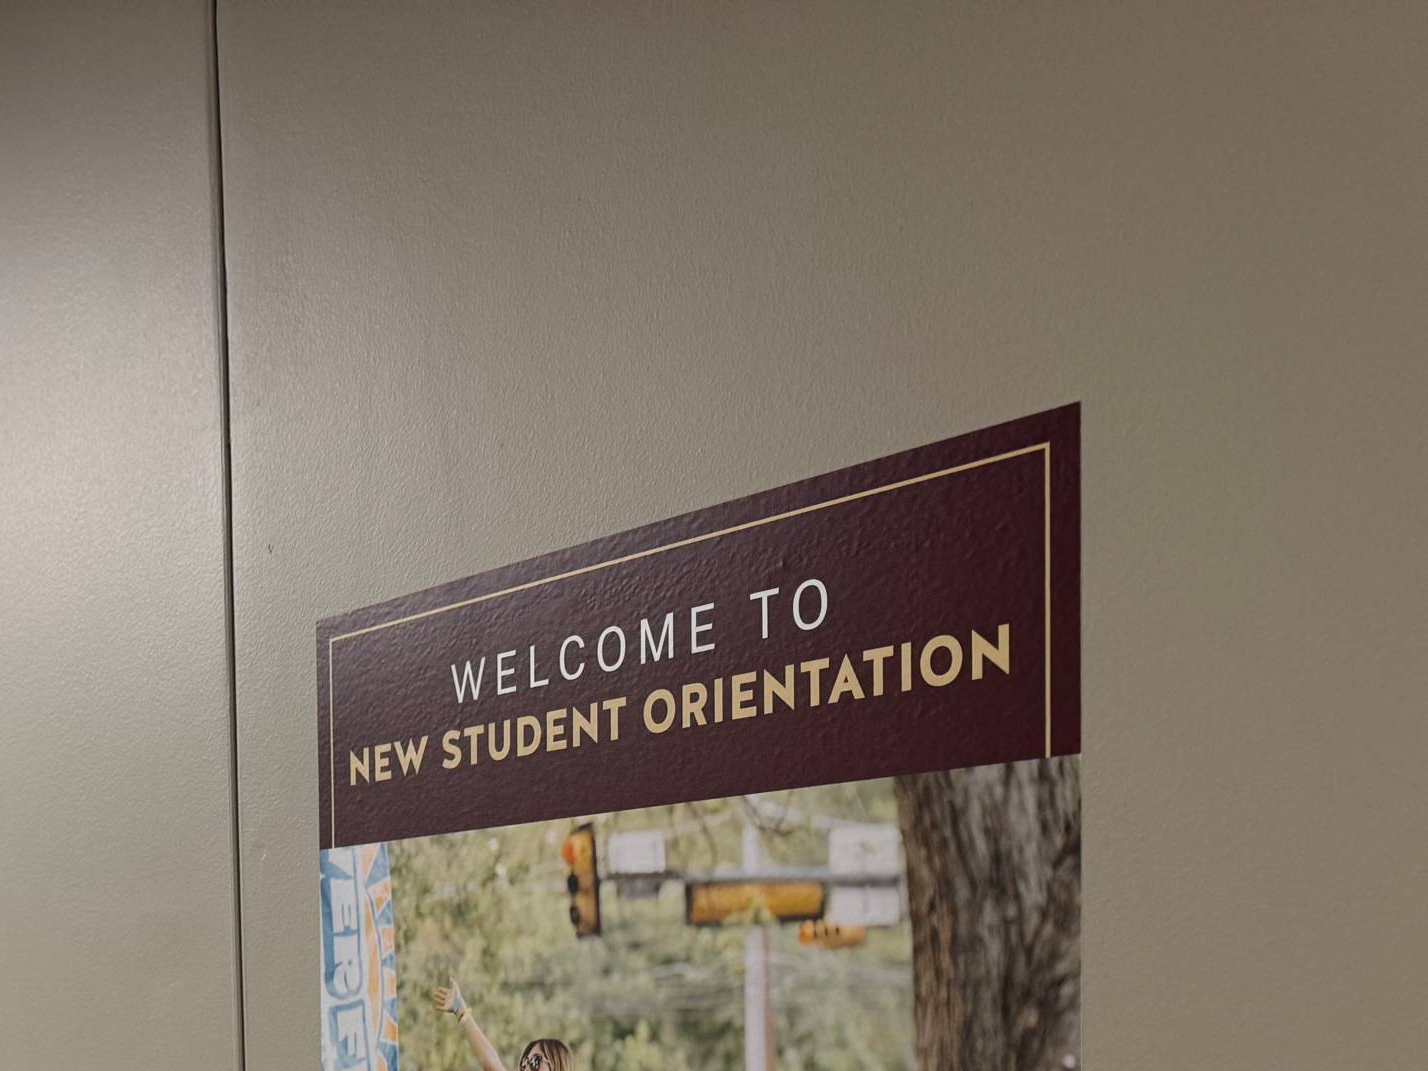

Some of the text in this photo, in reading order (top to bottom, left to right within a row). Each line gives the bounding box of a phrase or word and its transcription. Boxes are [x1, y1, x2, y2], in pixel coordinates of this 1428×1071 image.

[350, 623, 1011, 786] NEW STUDENT ORIENTATION
[450, 578, 829, 705] WELCOME TO
